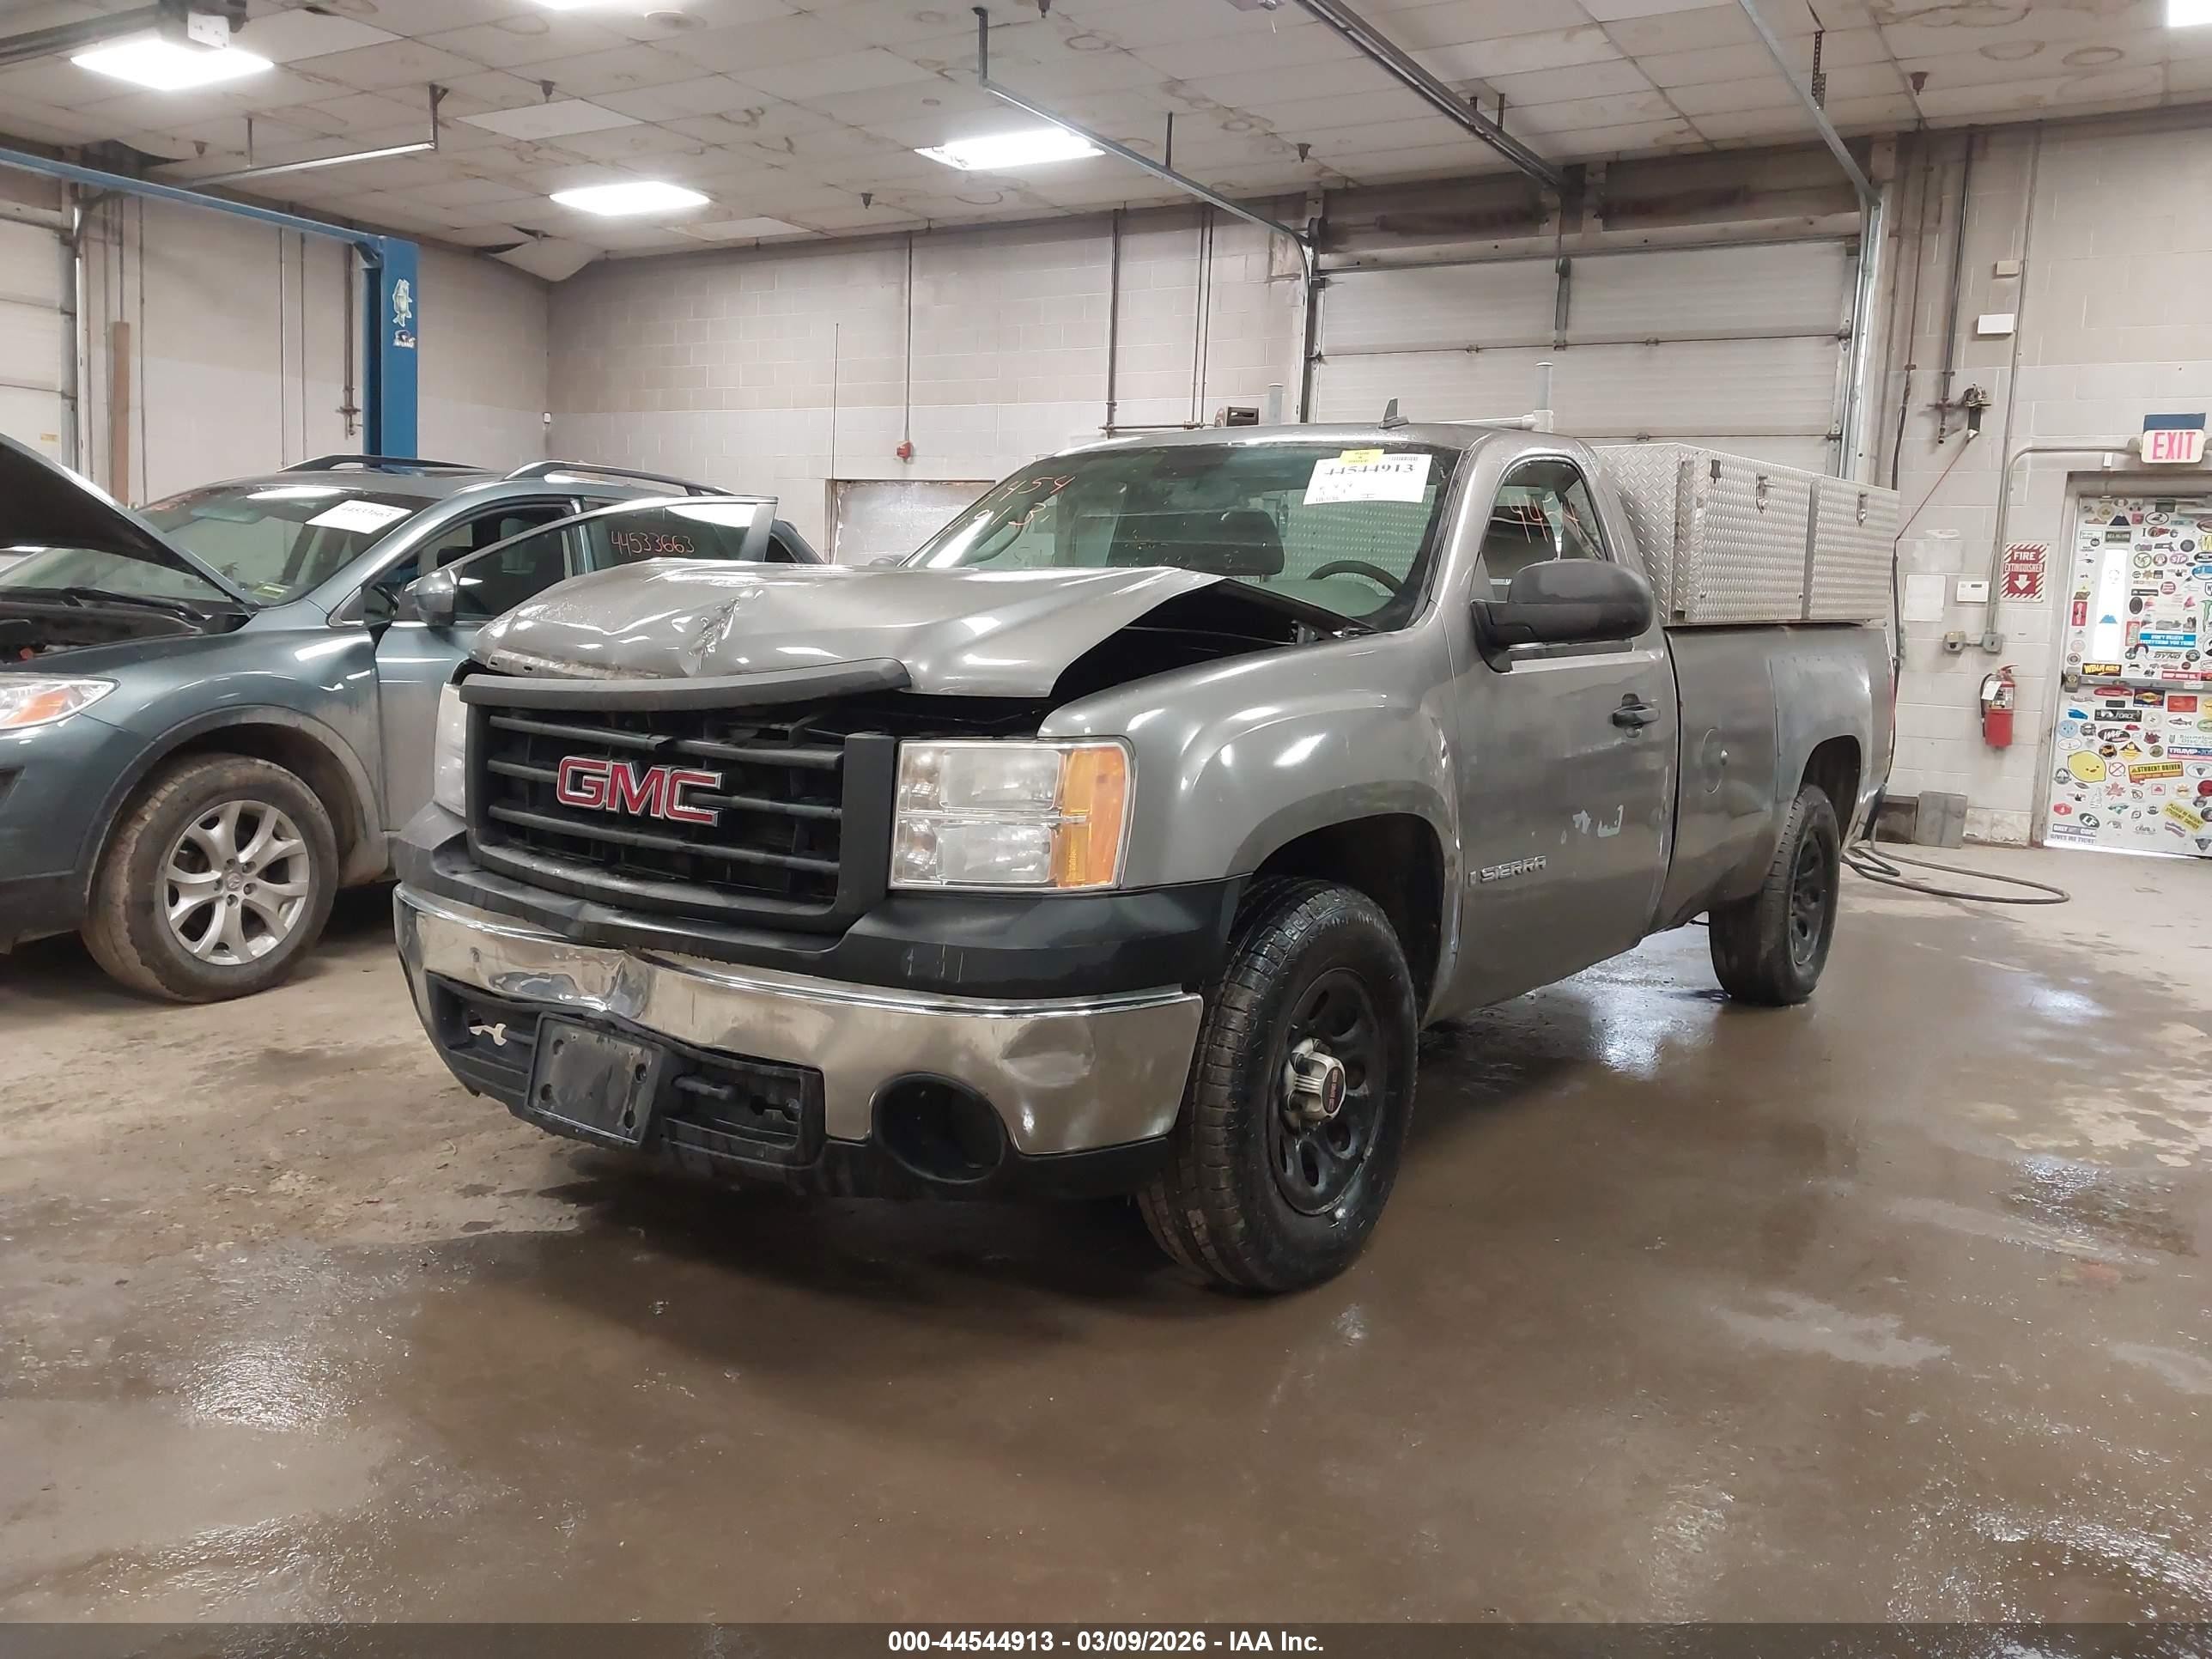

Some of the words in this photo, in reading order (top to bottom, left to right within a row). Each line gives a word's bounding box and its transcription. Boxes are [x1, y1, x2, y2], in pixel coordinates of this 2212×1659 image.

[2152, 431, 2197, 460] EXIT
[1324, 463, 1415, 476] 44544913
[611, 529, 695, 557] 44533663
[2014, 551, 2036, 561] FIRE
[556, 756, 723, 827] GMC
[1480, 855, 1547, 883] SIERRA
